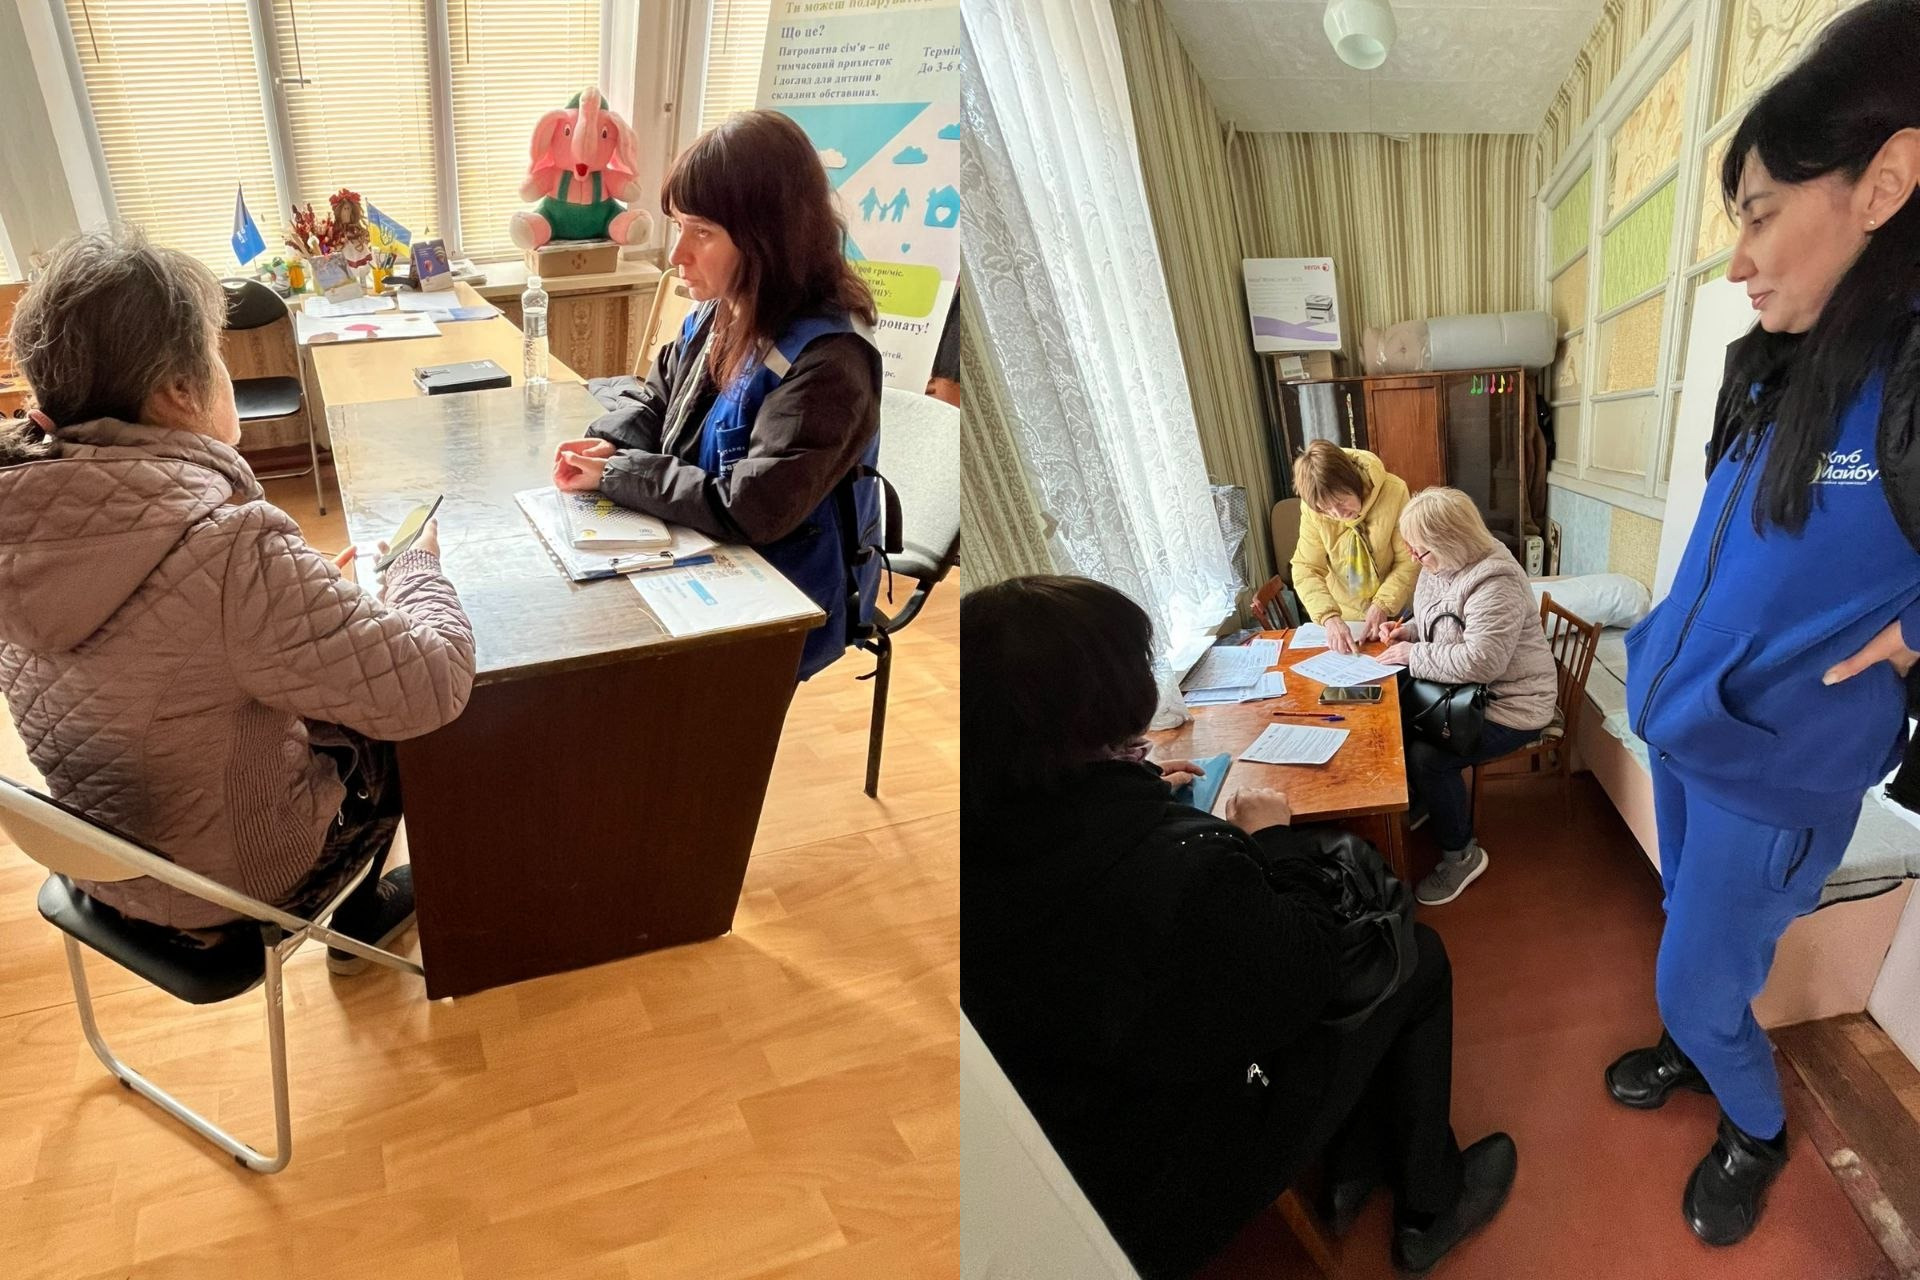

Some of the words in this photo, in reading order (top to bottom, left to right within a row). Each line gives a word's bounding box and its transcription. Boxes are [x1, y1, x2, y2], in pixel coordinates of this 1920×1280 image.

[785, 2, 801, 13] Ти
[804, 0, 845, 12] можеш
[781, 26, 801, 39] Що
[805, 24, 825, 38] це?
[779, 46, 838, 58] Патронатна
[878, 42, 890, 52] це
[776, 60, 835, 71] тимчасовий
[837, 58, 893, 70] прихисток
[917, 62, 933, 75] До
[935, 61, 954, 72] 3-6
[779, 76, 812, 86] догляд
[814, 76, 833, 85] для
[835, 75, 872, 84] дитини
[875, 73, 881, 82] в
[771, 91, 816, 100] складних
[819, 89, 879, 99] обставинах.
[878, 319, 930, 335] ронату!
[1827, 449, 1863, 465] Клуб
[1821, 463, 1880, 482] Майбу
